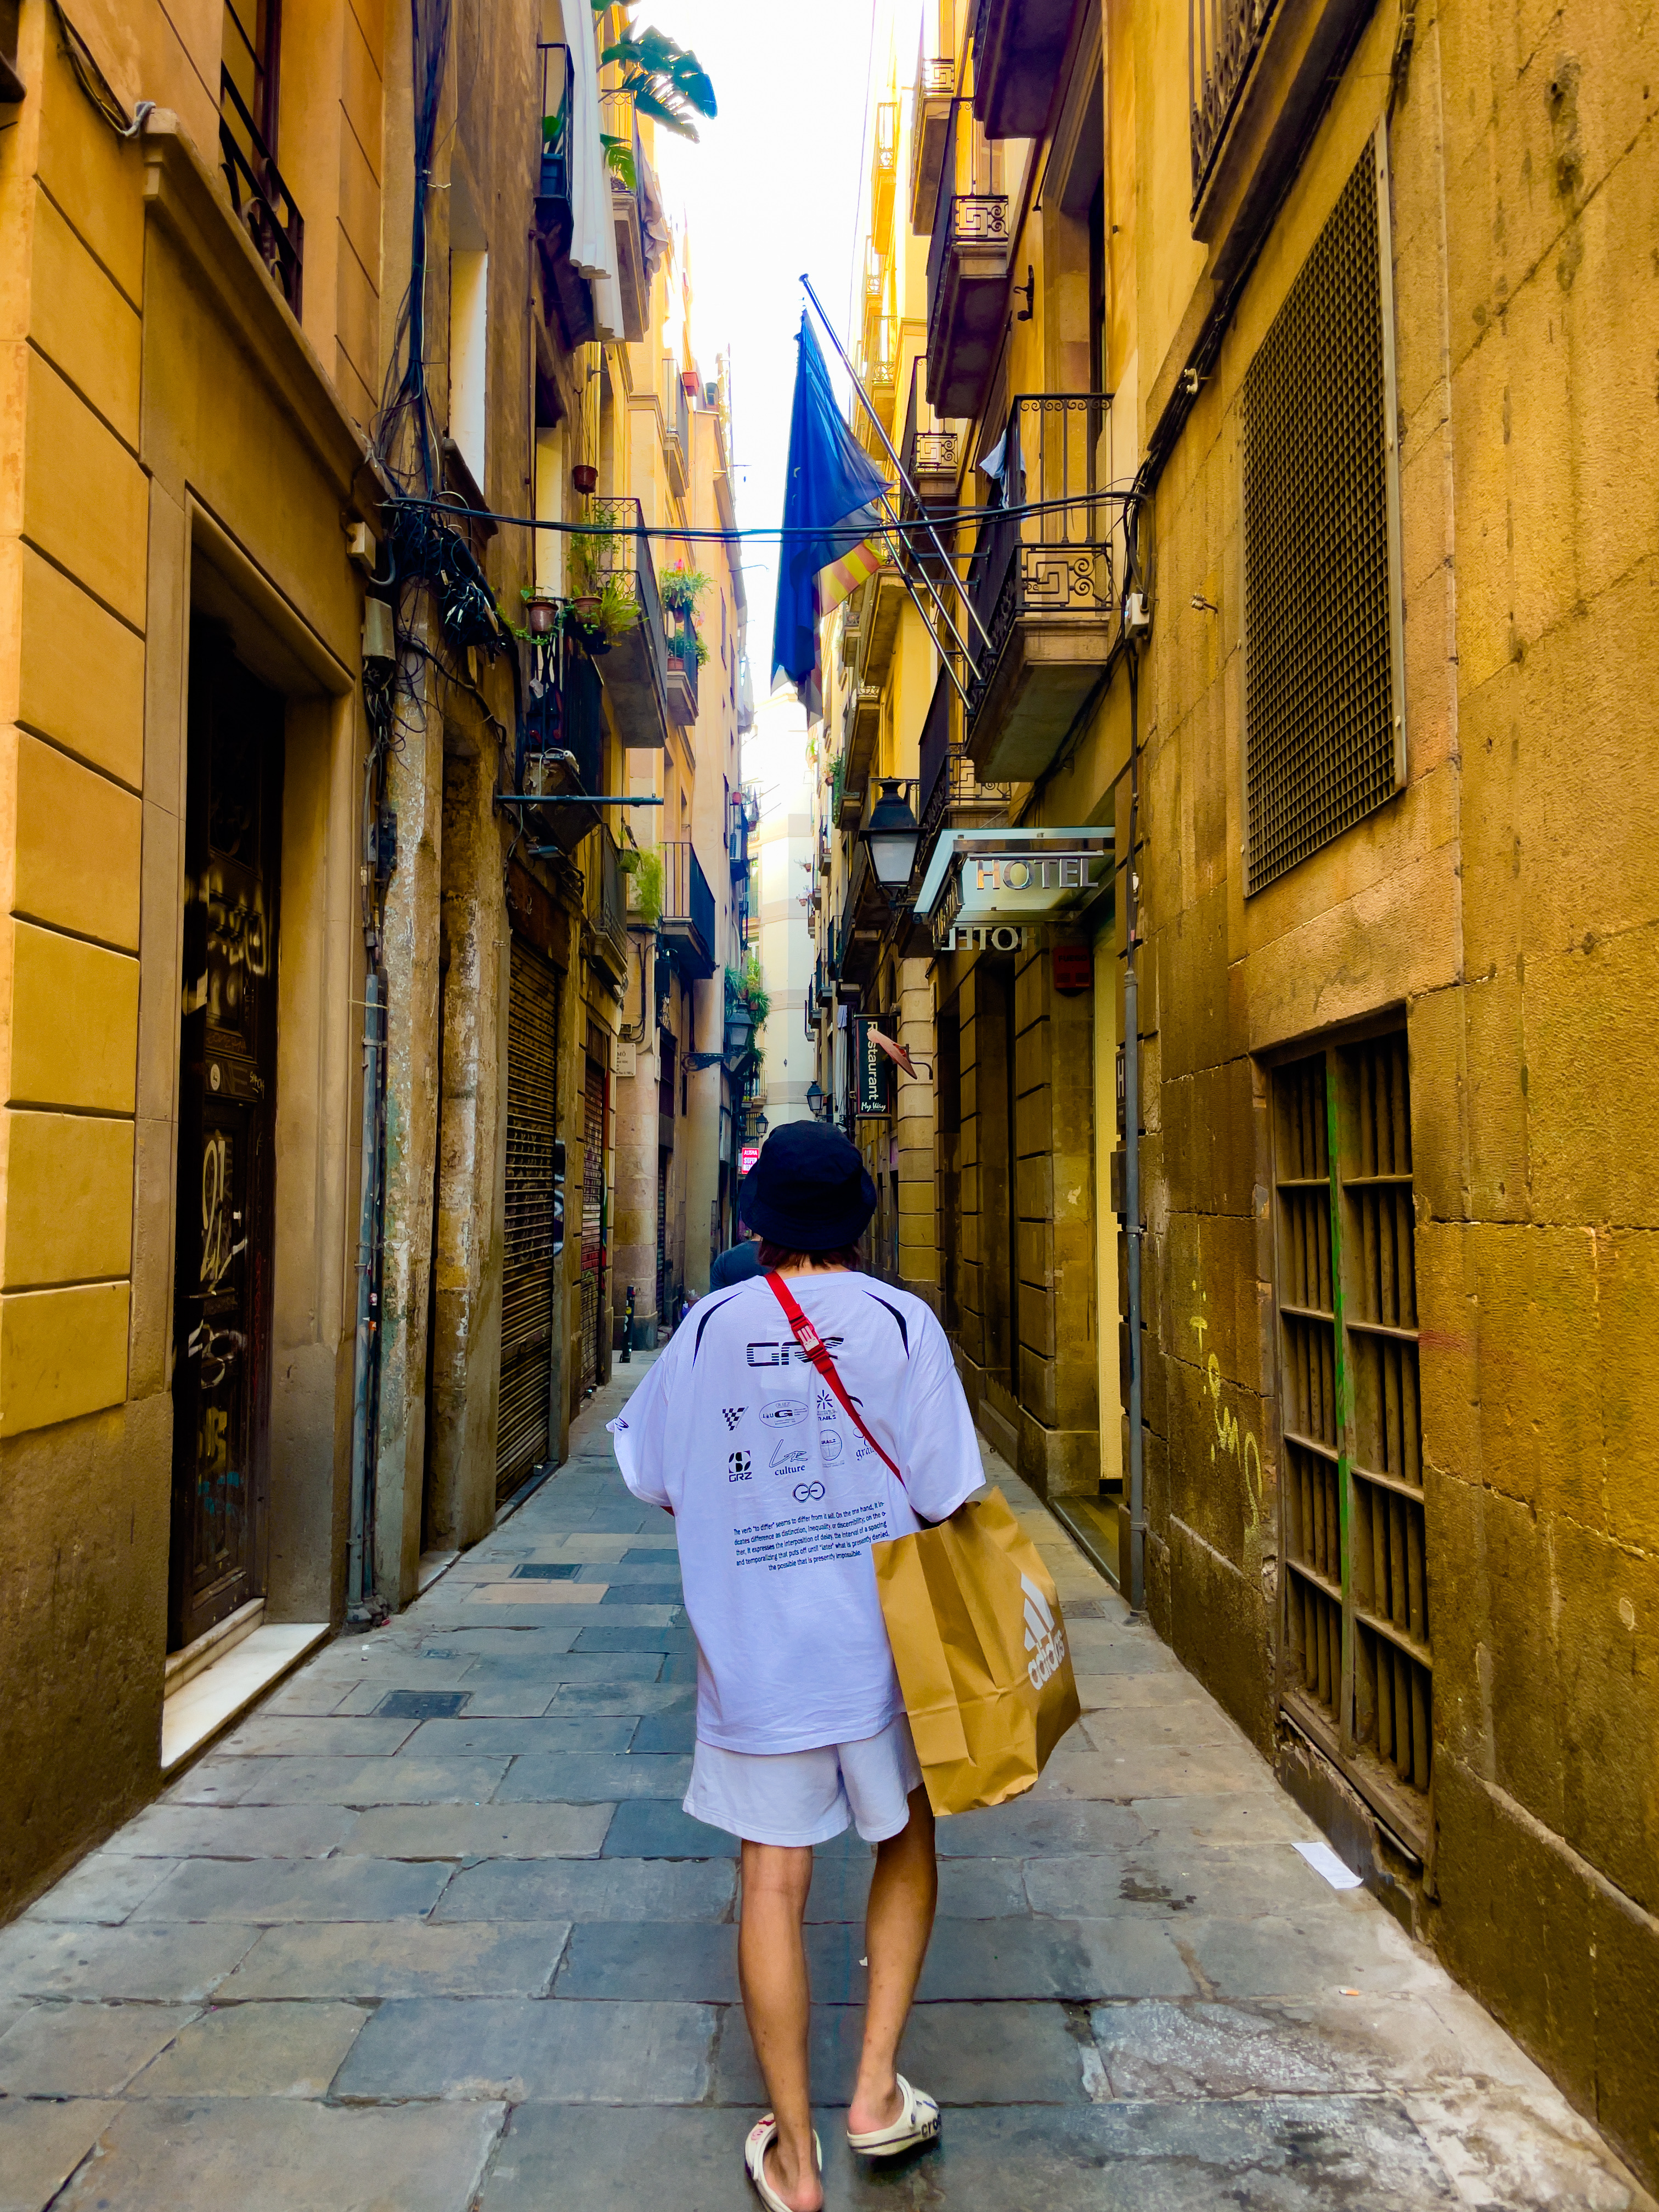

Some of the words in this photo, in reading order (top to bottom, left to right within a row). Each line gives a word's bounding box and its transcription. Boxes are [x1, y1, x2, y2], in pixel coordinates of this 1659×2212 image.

[977, 858, 1099, 890] HOTEL
[867, 1022, 879, 1100] Rstaurant
[775, 1465, 805, 1476] culture
[729, 1471, 752, 1482] GRZ
[776, 1520, 791, 1528] seems
[751, 1534, 774, 1543] difference
[752, 1544, 775, 1553] expresses
[784, 1536, 814, 1547] interposition
[868, 1521, 887, 1531] spacing
[789, 1549, 799, 1558] puts
[777, 1560, 796, 1571] possible
